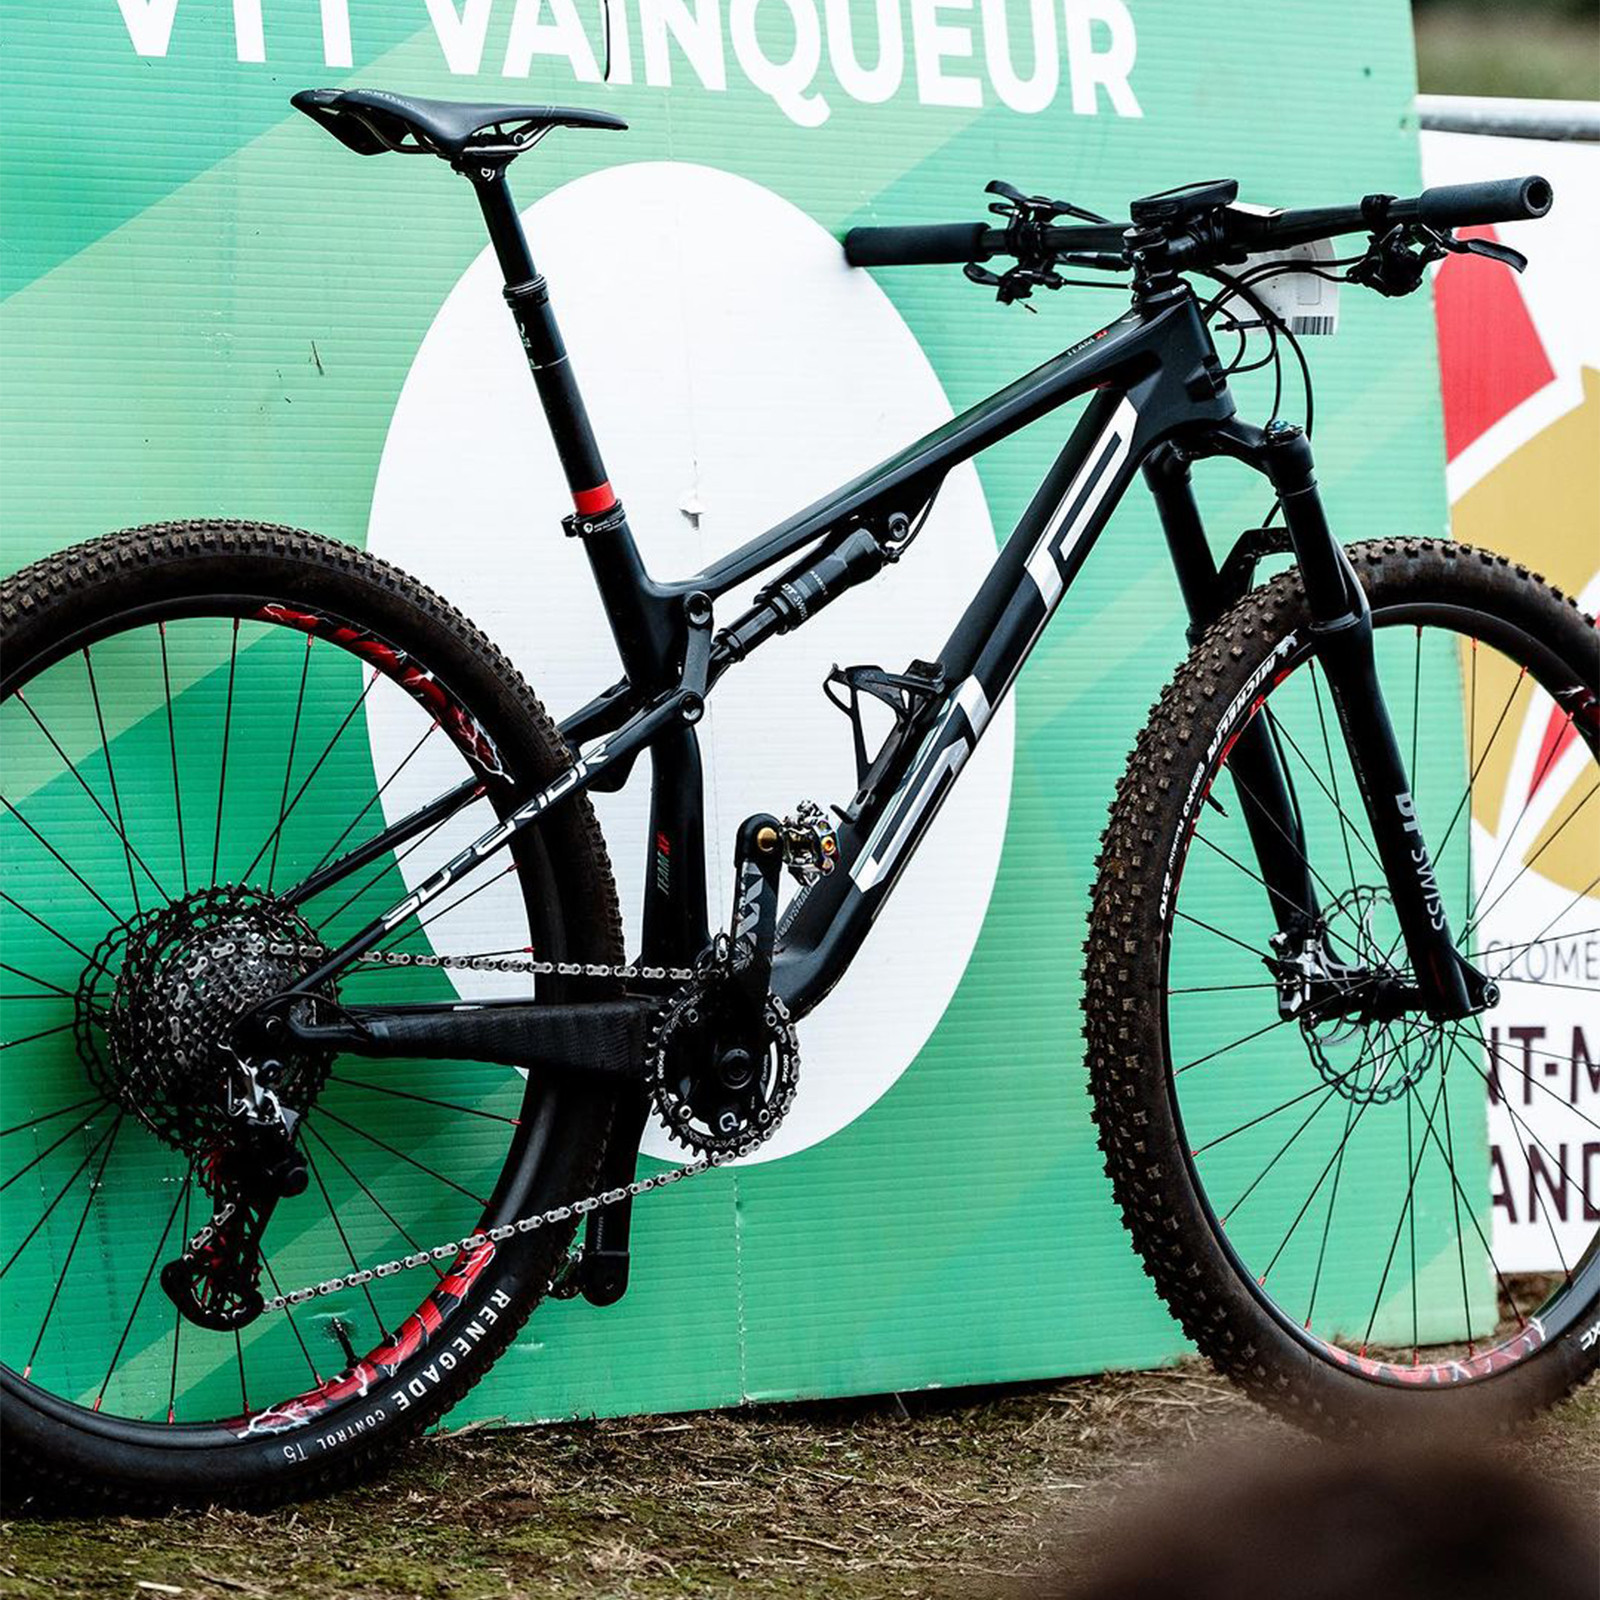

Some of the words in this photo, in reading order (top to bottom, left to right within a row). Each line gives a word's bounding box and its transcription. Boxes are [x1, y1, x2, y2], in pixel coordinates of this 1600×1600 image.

[424, 0, 1145, 128] VAINQUEUR
[1206, 654, 1277, 764] MICHELIN
[380, 743, 609, 931] SUPERIOR
[1395, 791, 1423, 837] DT
[1411, 846, 1447, 932] SWISS
[390, 1288, 512, 1412] RENEGADE
[316, 1408, 387, 1450] CONTROL
